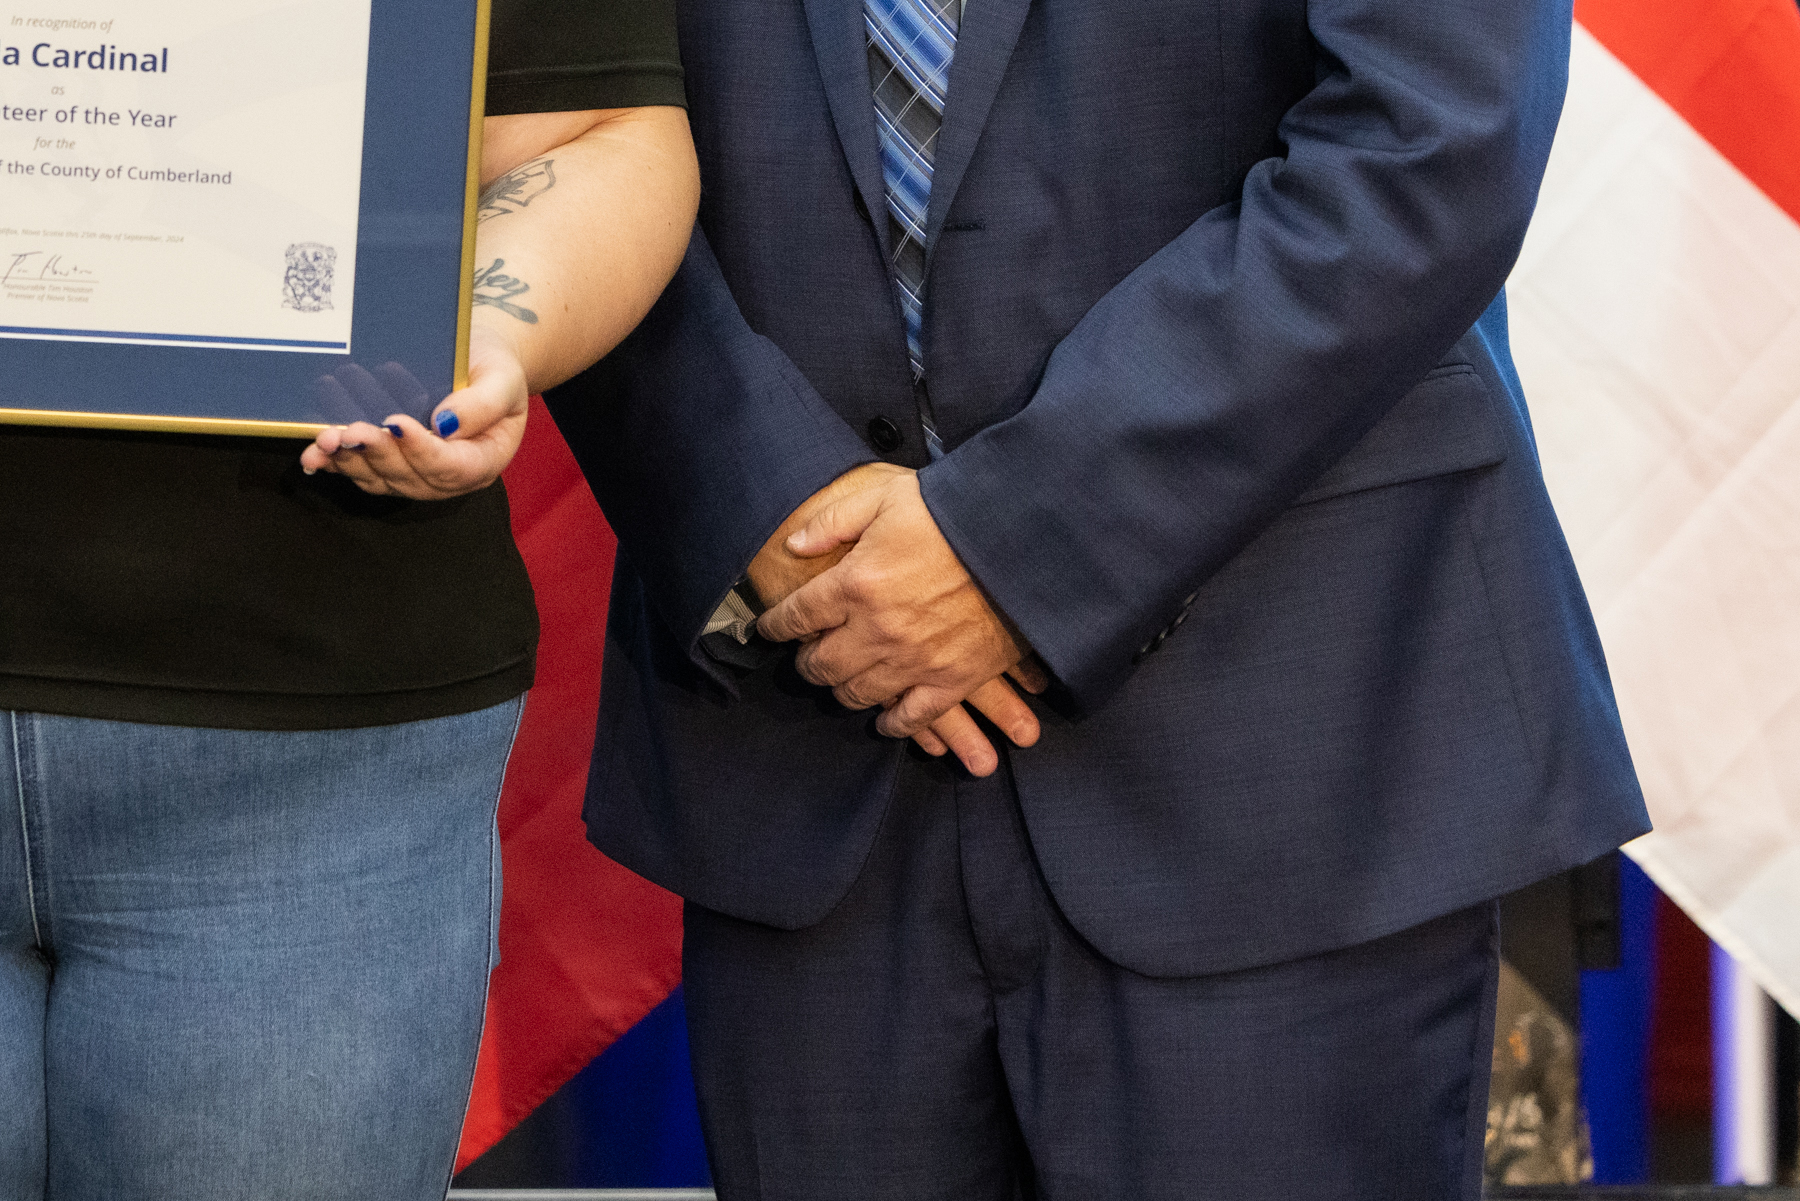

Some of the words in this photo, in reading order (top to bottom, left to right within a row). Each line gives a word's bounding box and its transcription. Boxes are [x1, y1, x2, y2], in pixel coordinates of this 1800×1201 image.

[10, 15, 24, 27] In
[26, 17, 97, 31] recognition
[99, 18, 115, 34] of
[32, 43, 169, 73] Cardinal
[50, 85, 66, 96] as
[55, 106, 78, 124] of
[84, 107, 121, 126] the
[128, 109, 178, 128] Year
[32, 136, 53, 151] for
[56, 137, 76, 150] the
[7, 160, 35, 175] the
[40, 162, 101, 181] County
[105, 165, 123, 179] of
[127, 166, 233, 185] Cumberland
